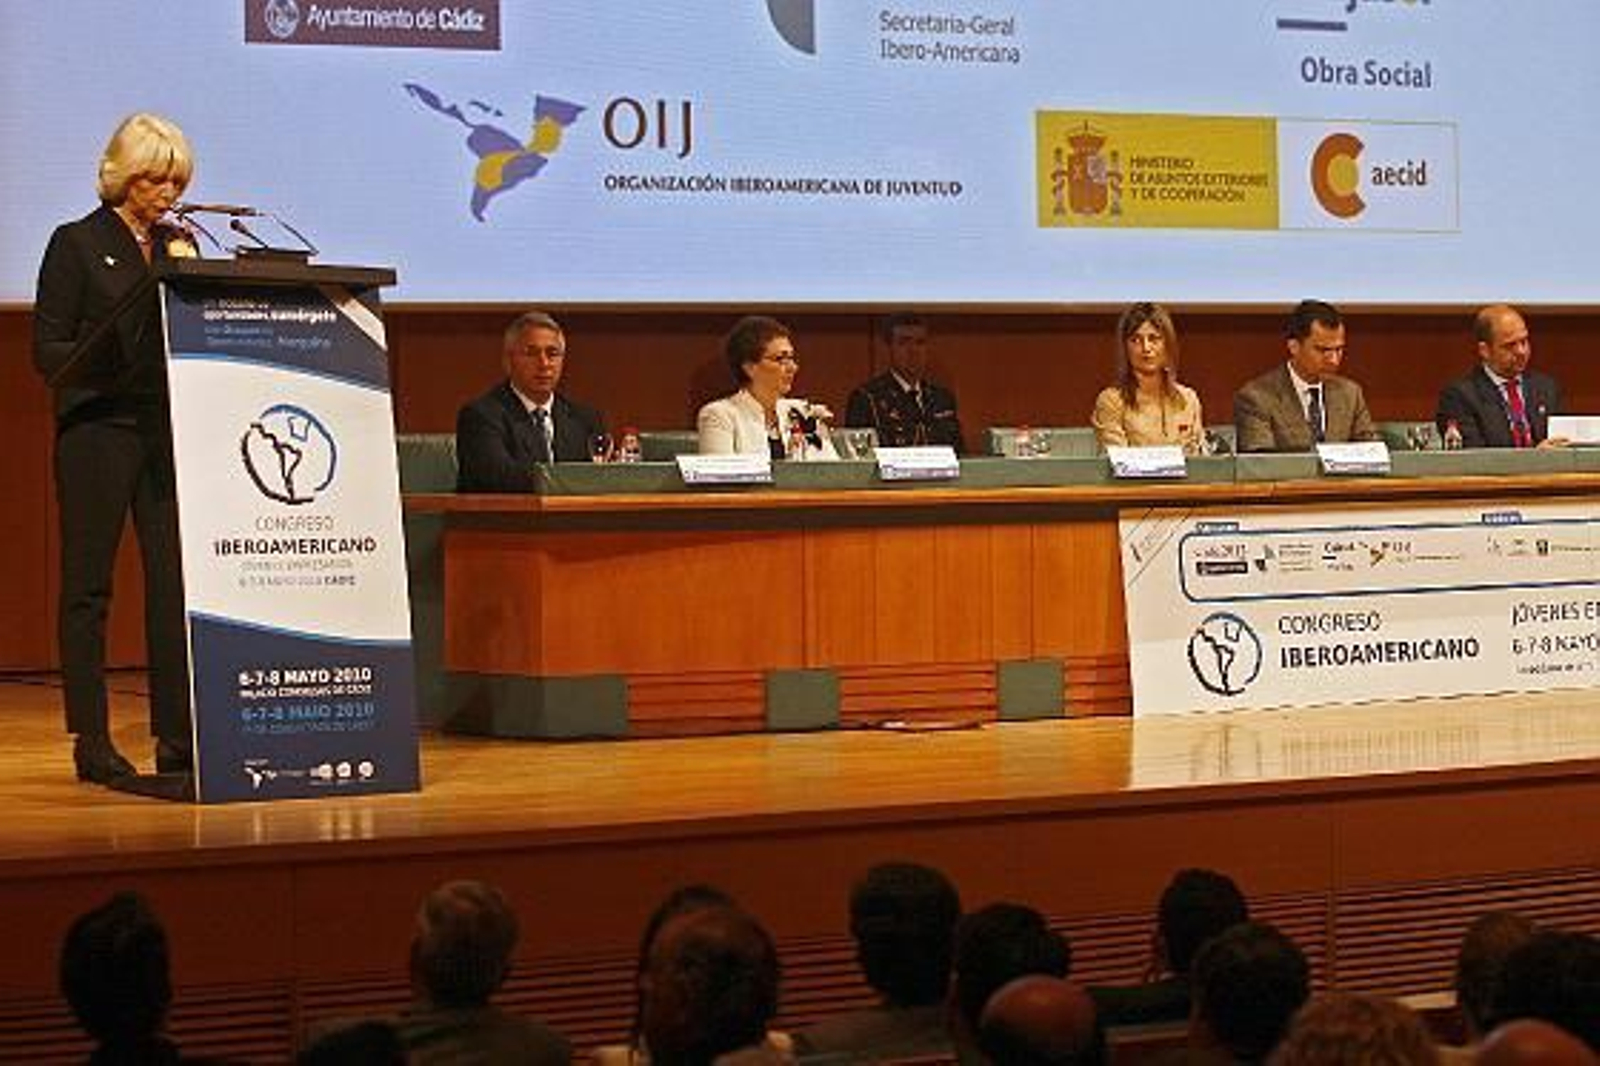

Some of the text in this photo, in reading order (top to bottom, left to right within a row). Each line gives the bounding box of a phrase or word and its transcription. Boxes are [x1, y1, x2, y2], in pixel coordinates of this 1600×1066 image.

[306, 5, 485, 32] Ayuntamiento de Cádiz
[881, 39, 1020, 64] Ibero-Americana
[1301, 56, 1432, 89] Obra Social
[603, 96, 692, 159] OIJ
[604, 173, 963, 197] ORGANIZACIÓN IBEROAMERICANA DE JUVENTUD
[1371, 159, 1427, 187] aecid
[255, 515, 335, 532] CONGRESO
[213, 537, 377, 556] IBEROAMERICANO
[1278, 611, 1382, 635] CONGRESO
[1512, 602, 1579, 626] JÓVENES
[1281, 637, 1480, 669] IBEROAMERICANO
[238, 666, 372, 687] 6-7-8 MAYO 2010
